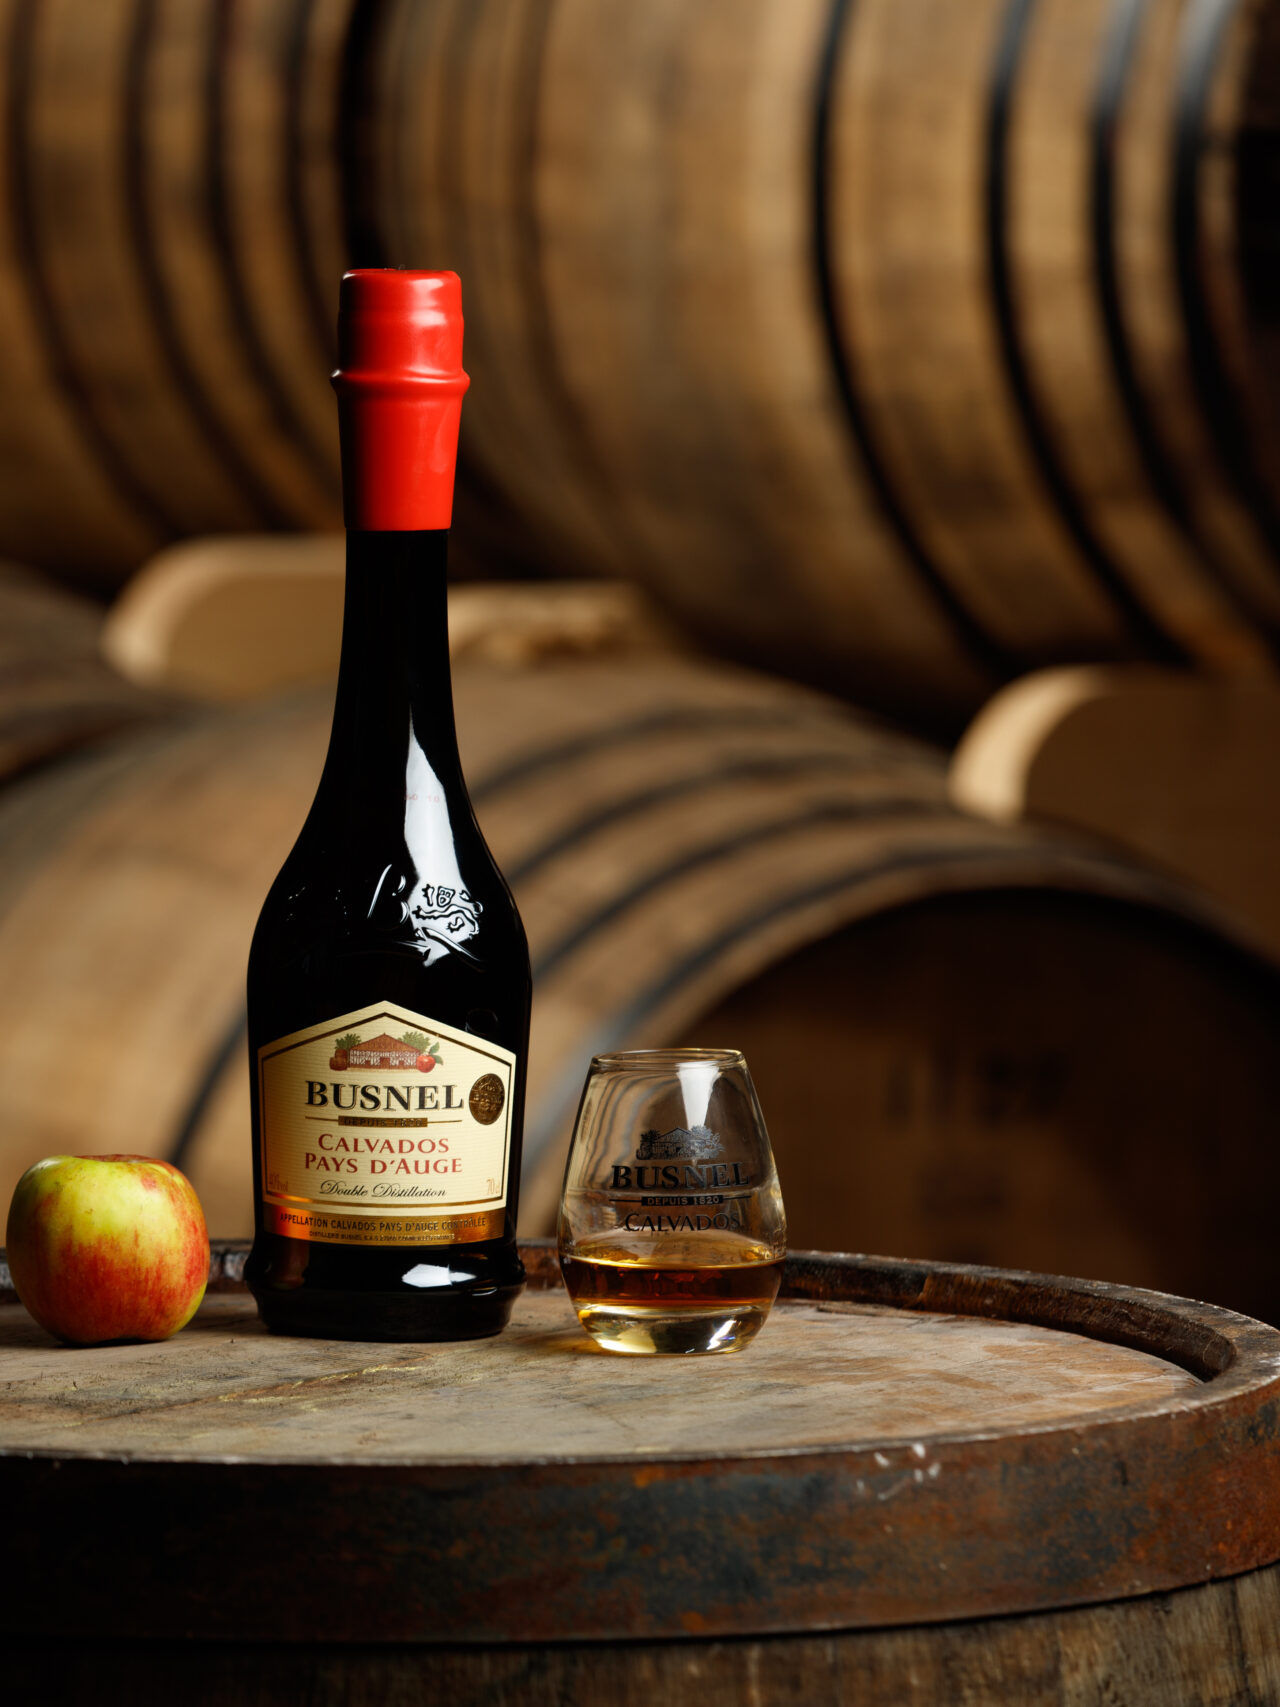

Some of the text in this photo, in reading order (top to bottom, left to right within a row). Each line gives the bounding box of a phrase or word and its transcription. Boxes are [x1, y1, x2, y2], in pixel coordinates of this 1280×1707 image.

[304, 1080, 464, 1112] BUSNEL
[318, 1133, 449, 1154] CALVADOS
[305, 1152, 463, 1175] PAYS D'AUGE
[611, 1162, 750, 1190] BUSNEL
[318, 1180, 447, 1198] Double Distillation
[646, 1195, 720, 1206] DEPUIS 1820
[280, 1213, 486, 1231] APPELLATION CALVADOS PAYS D'AUGE CONTRÔLÉE
[625, 1212, 740, 1232] CALVADOS
